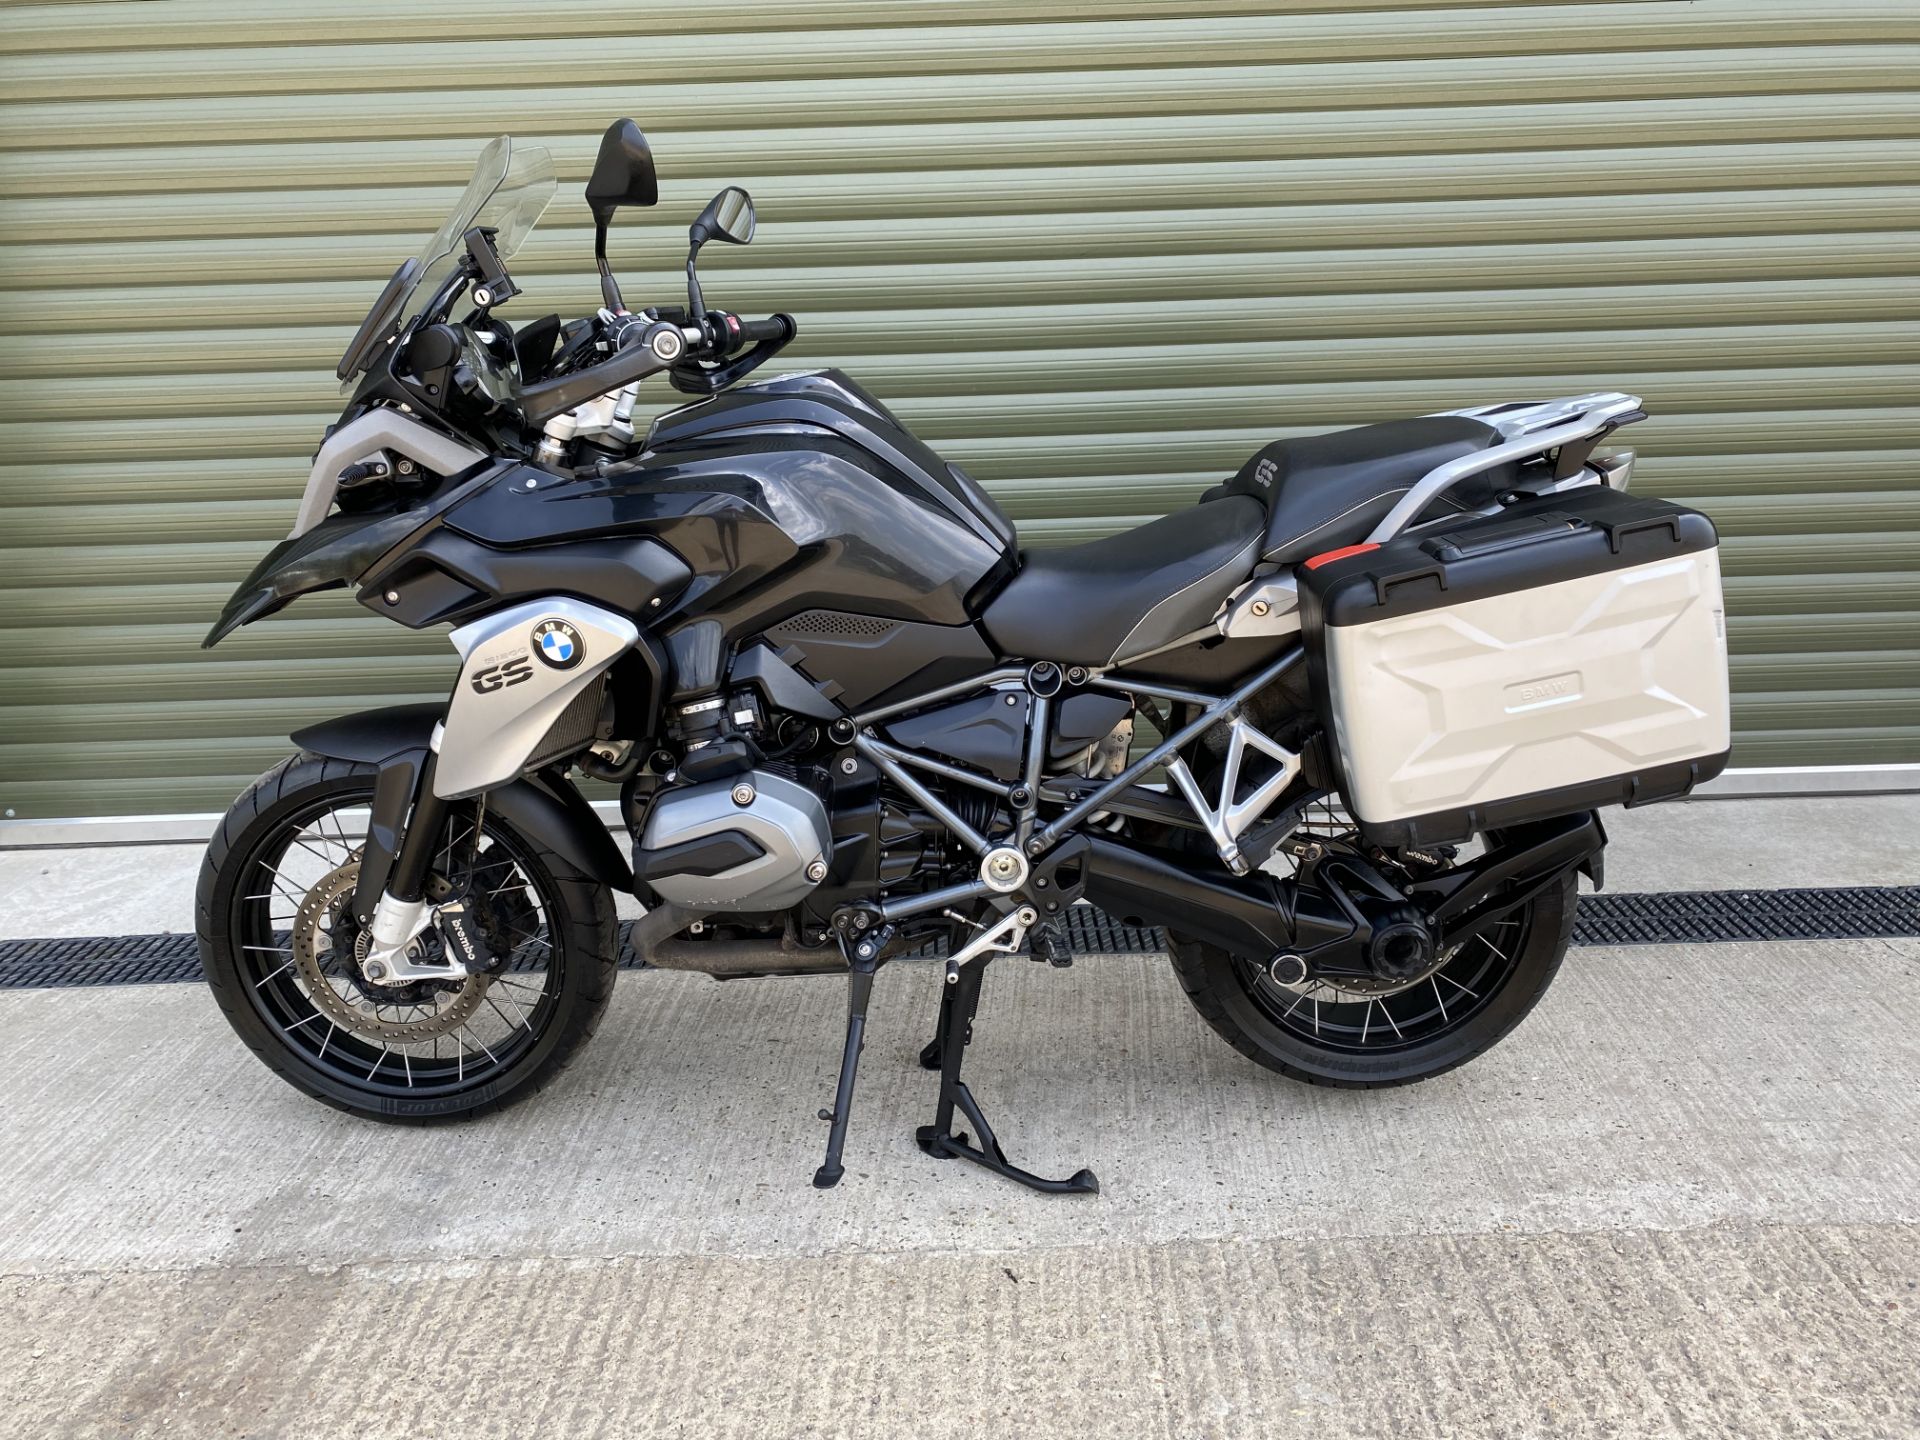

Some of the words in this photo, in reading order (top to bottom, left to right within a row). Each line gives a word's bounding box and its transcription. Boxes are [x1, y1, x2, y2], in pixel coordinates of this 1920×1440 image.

[1255, 458, 1278, 488] GS
[534, 622, 574, 642] BMW
[471, 655, 534, 694] GS
[1521, 681, 1567, 700] BMW
[451, 919, 475, 960] brembo
